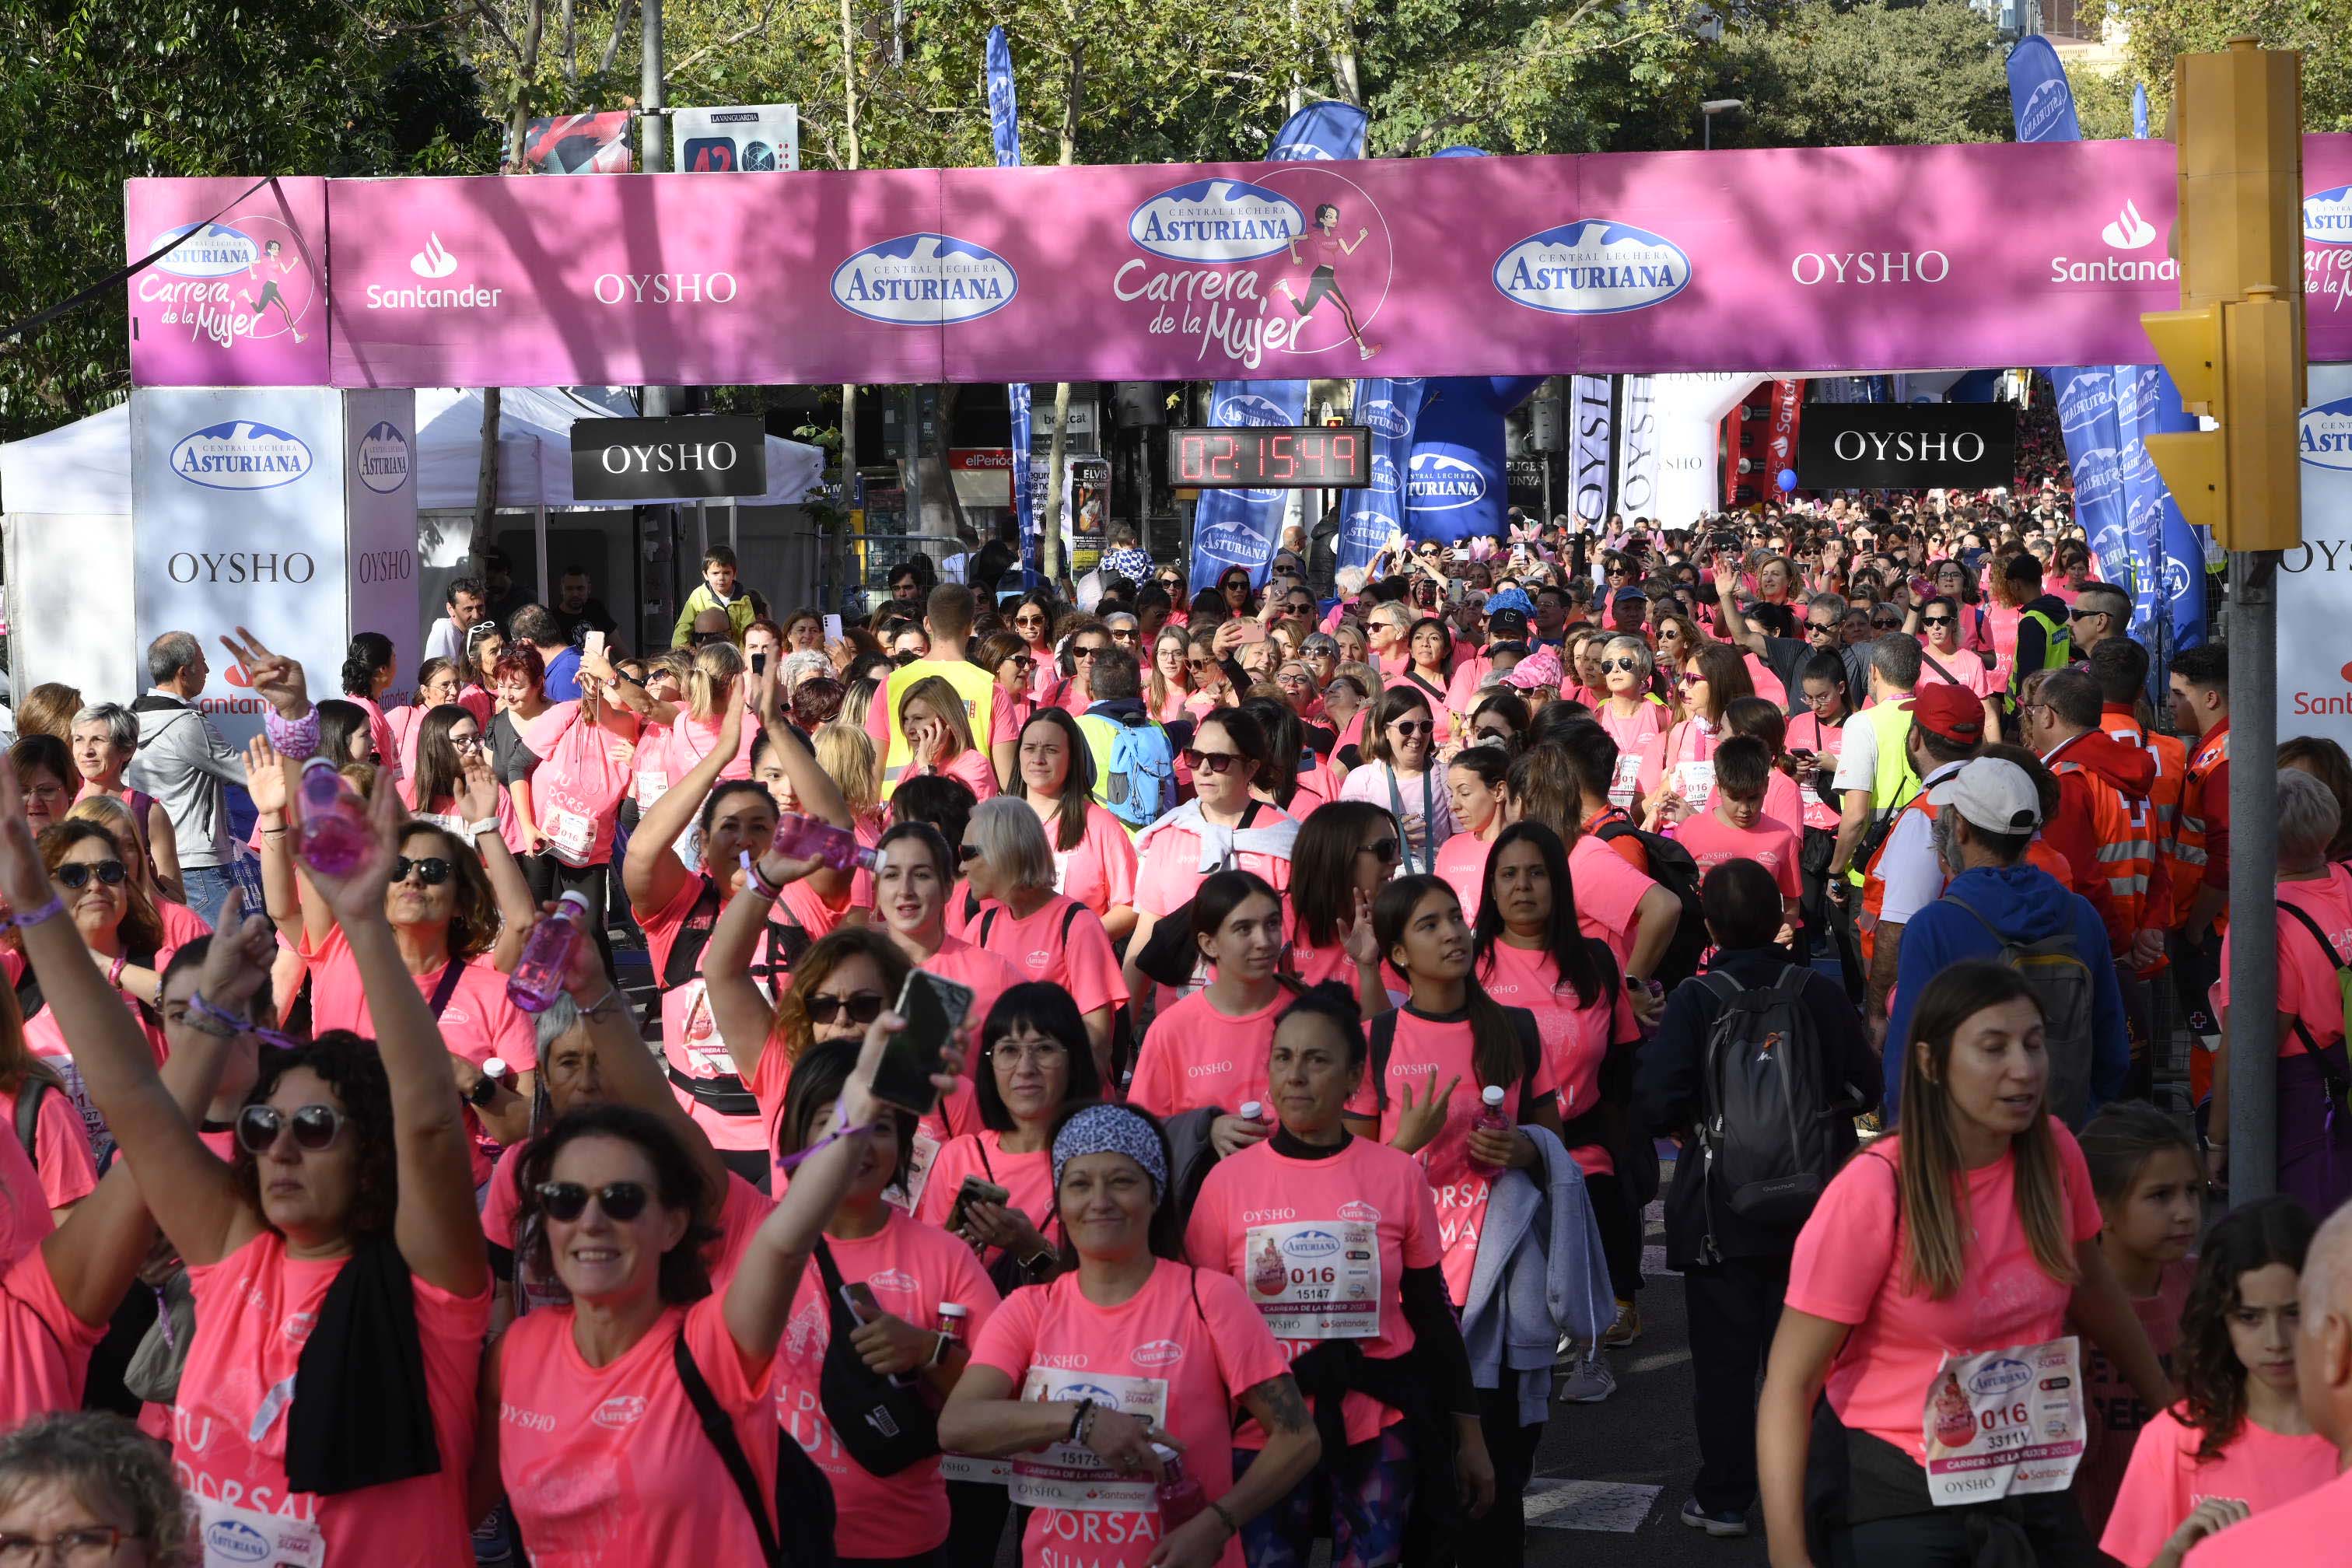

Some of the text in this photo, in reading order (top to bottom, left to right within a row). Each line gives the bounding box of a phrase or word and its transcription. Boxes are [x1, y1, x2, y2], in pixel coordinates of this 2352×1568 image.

[1169, 205, 1286, 216] CENTRAL LECHERA
[1142, 209, 1291, 243] ASTURIANA
[874, 264, 997, 275] CENTRAL LECHERA
[1538, 250, 1668, 263] CENTRAL LECHERA
[1791, 250, 1949, 285] OYSHO
[2051, 255, 2181, 282] Santand
[845, 268, 1004, 301] ASTURIANA
[1113, 258, 1259, 302] Carrera
[1507, 256, 1676, 291] ASTURIANA
[2323, 271, 2338, 293] la
[138, 274, 229, 303] Carrera
[366, 284, 502, 309] Santander
[593, 271, 737, 304] OYSHO
[162, 300, 265, 348] de la Mujer
[1149, 295, 1314, 370] de la Mujer
[202, 444, 298, 453] CENTRAL LECHERA
[601, 441, 737, 474] OYSHO
[1181, 435, 1356, 480] 02:15:49
[1834, 430, 1985, 462] OYSHO
[180, 446, 303, 473] ASTURIANA
[362, 447, 407, 477] ASTURIANA
[1083, 469, 1108, 479] ELVIS
[1437, 471, 1475, 480] LECHERA
[1202, 532, 1268, 561] ASTURIANA
[167, 551, 316, 584] OYSHO
[359, 548, 411, 584] OYSHO
[1702, 852, 1733, 860] OYSHO
[1188, 1060, 1233, 1078] OYSHO
[1391, 1062, 1440, 1077] OYSHO
[1242, 1207, 1296, 1223] OYSHO
[1286, 1241, 1337, 1252] ASTURIANA
[1290, 1266, 1336, 1284] 016
[1296, 1288, 1331, 1300] 15147
[1323, 1304, 1348, 1312] MUJER
[1331, 1319, 1370, 1328] Santander
[174, 1404, 211, 1453] TU
[1980, 1402, 2028, 1430] 016
[1946, 1456, 1992, 1470] CARRERA
[1993, 1454, 2007, 1465] DE
[1017, 1482, 1146, 1501] OYSHO Santander
[1944, 1478, 1996, 1494] OYSHO
